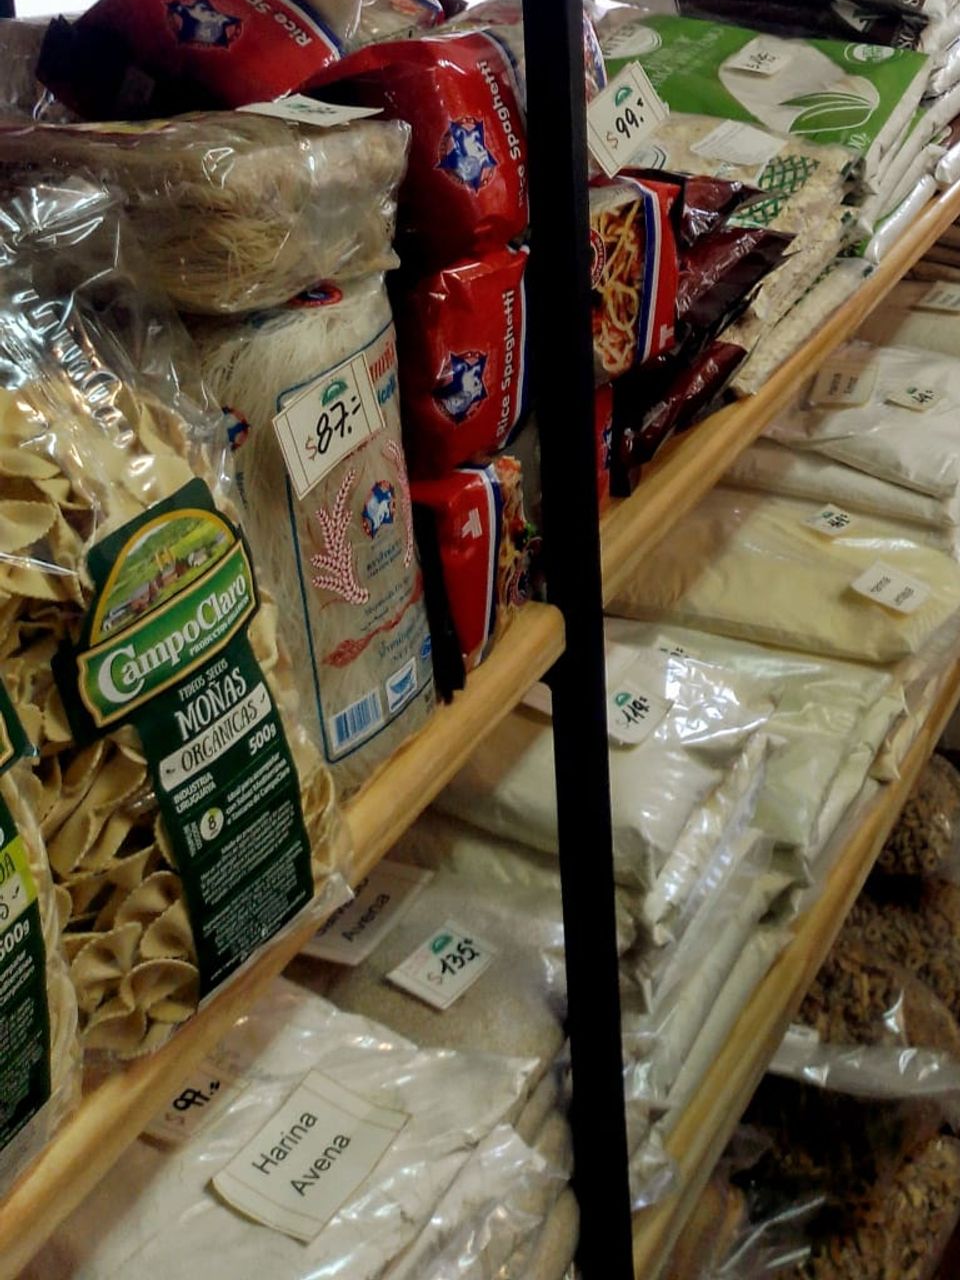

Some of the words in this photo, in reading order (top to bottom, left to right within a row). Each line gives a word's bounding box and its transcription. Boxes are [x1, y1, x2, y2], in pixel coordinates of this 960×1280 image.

[273, 5, 311, 48] Rice
[476, 59, 522, 160] Spaghetti
[501, 288, 515, 391] Spaghetti
[97, 572, 247, 704] CampoClaro
[173, 667, 248, 743] MOÑAS
[247, 724, 278, 756] 500g
[172, 771, 215, 804] INDUSTRIA
[341, 892, 391, 945] Avena
[250, 1109, 320, 1177] Harina
[290, 1131, 353, 1198] Avena
